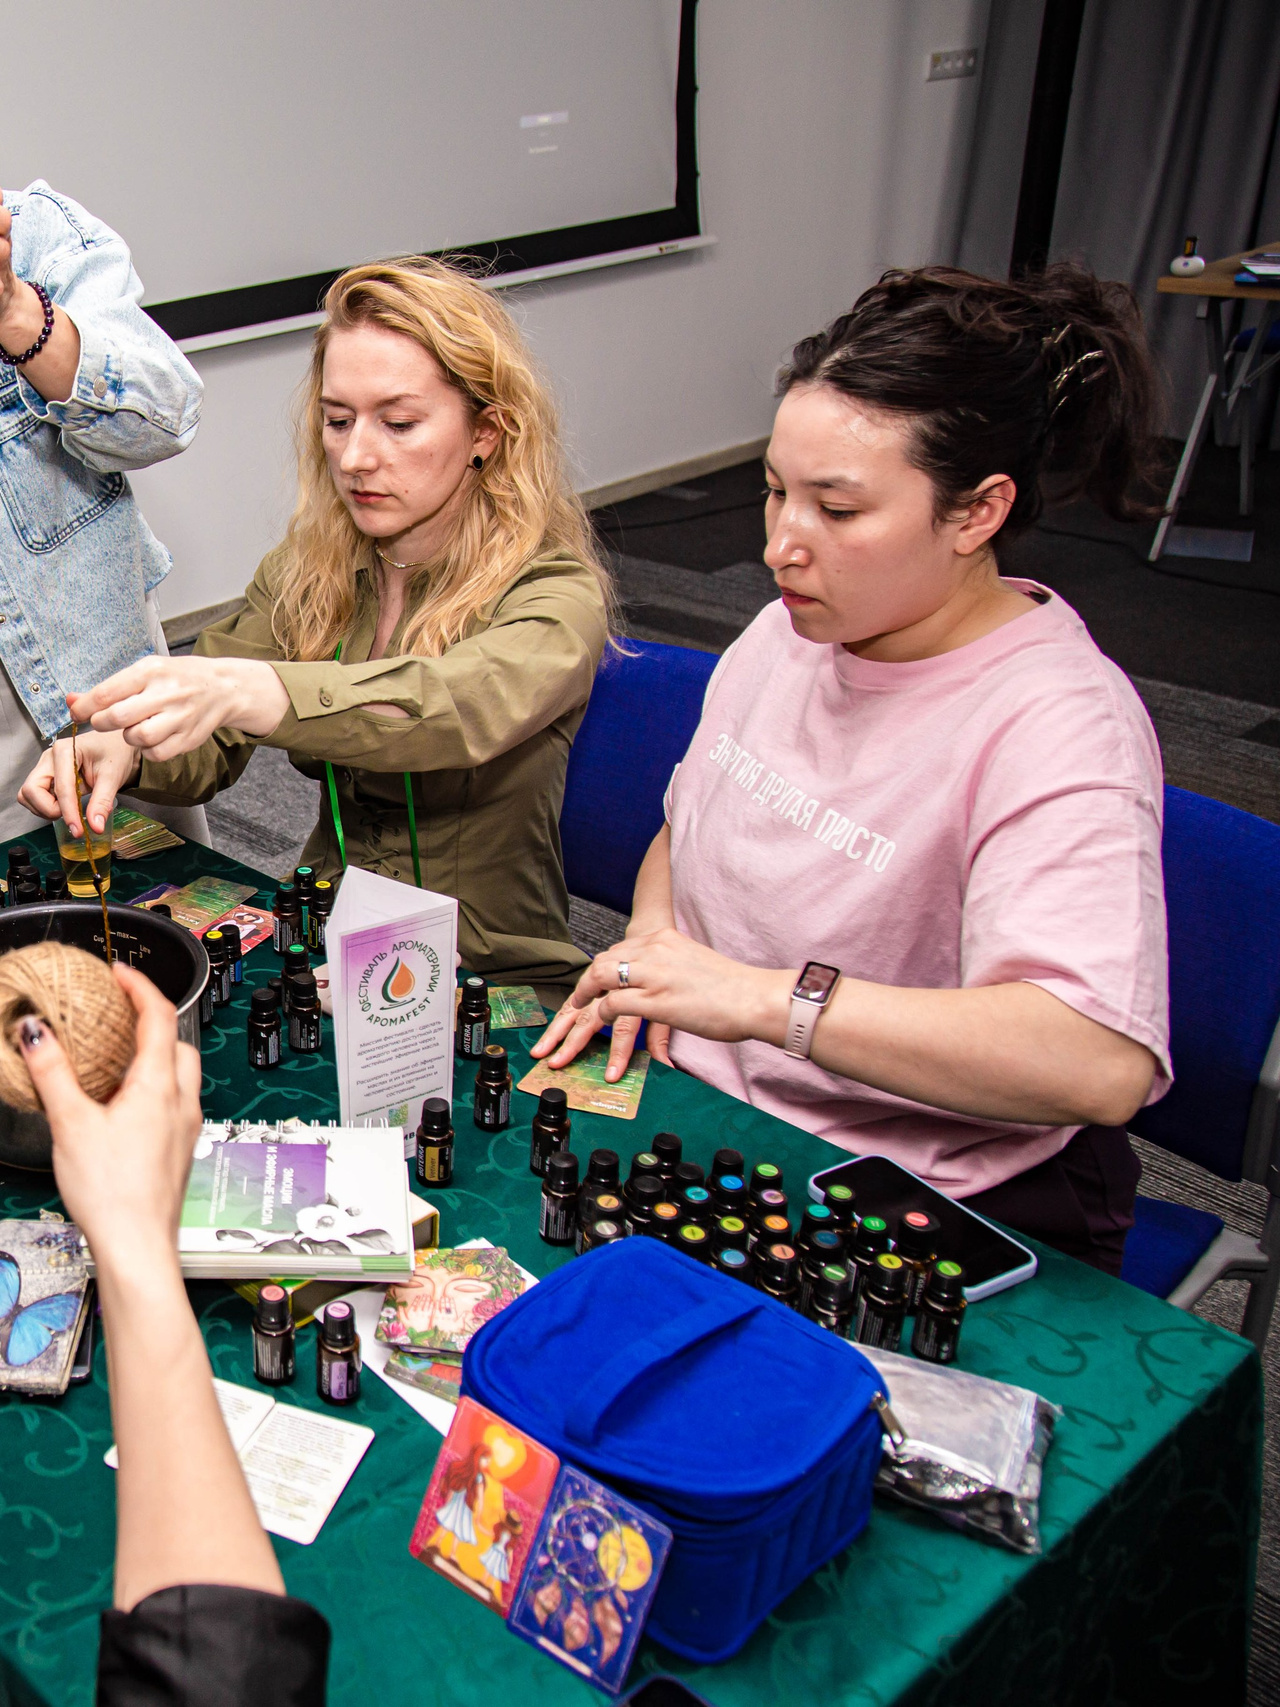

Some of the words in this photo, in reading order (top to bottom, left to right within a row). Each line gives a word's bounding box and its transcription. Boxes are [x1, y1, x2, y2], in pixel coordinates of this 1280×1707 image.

[752, 771, 820, 831] ДРУГАЯ
[93, 935, 104, 943] Cup
[117, 931, 130, 939] max
[358, 952, 388, 1012] ФЕСТИВАЛЬ
[392, 940, 440, 992] АРОМАТЕРАПИИ
[263, 1154, 277, 1194] ЭФИРНЫЕ
[280, 1168, 294, 1204] ЭМОЦИИ
[261, 1195, 273, 1226] МАСЛА
